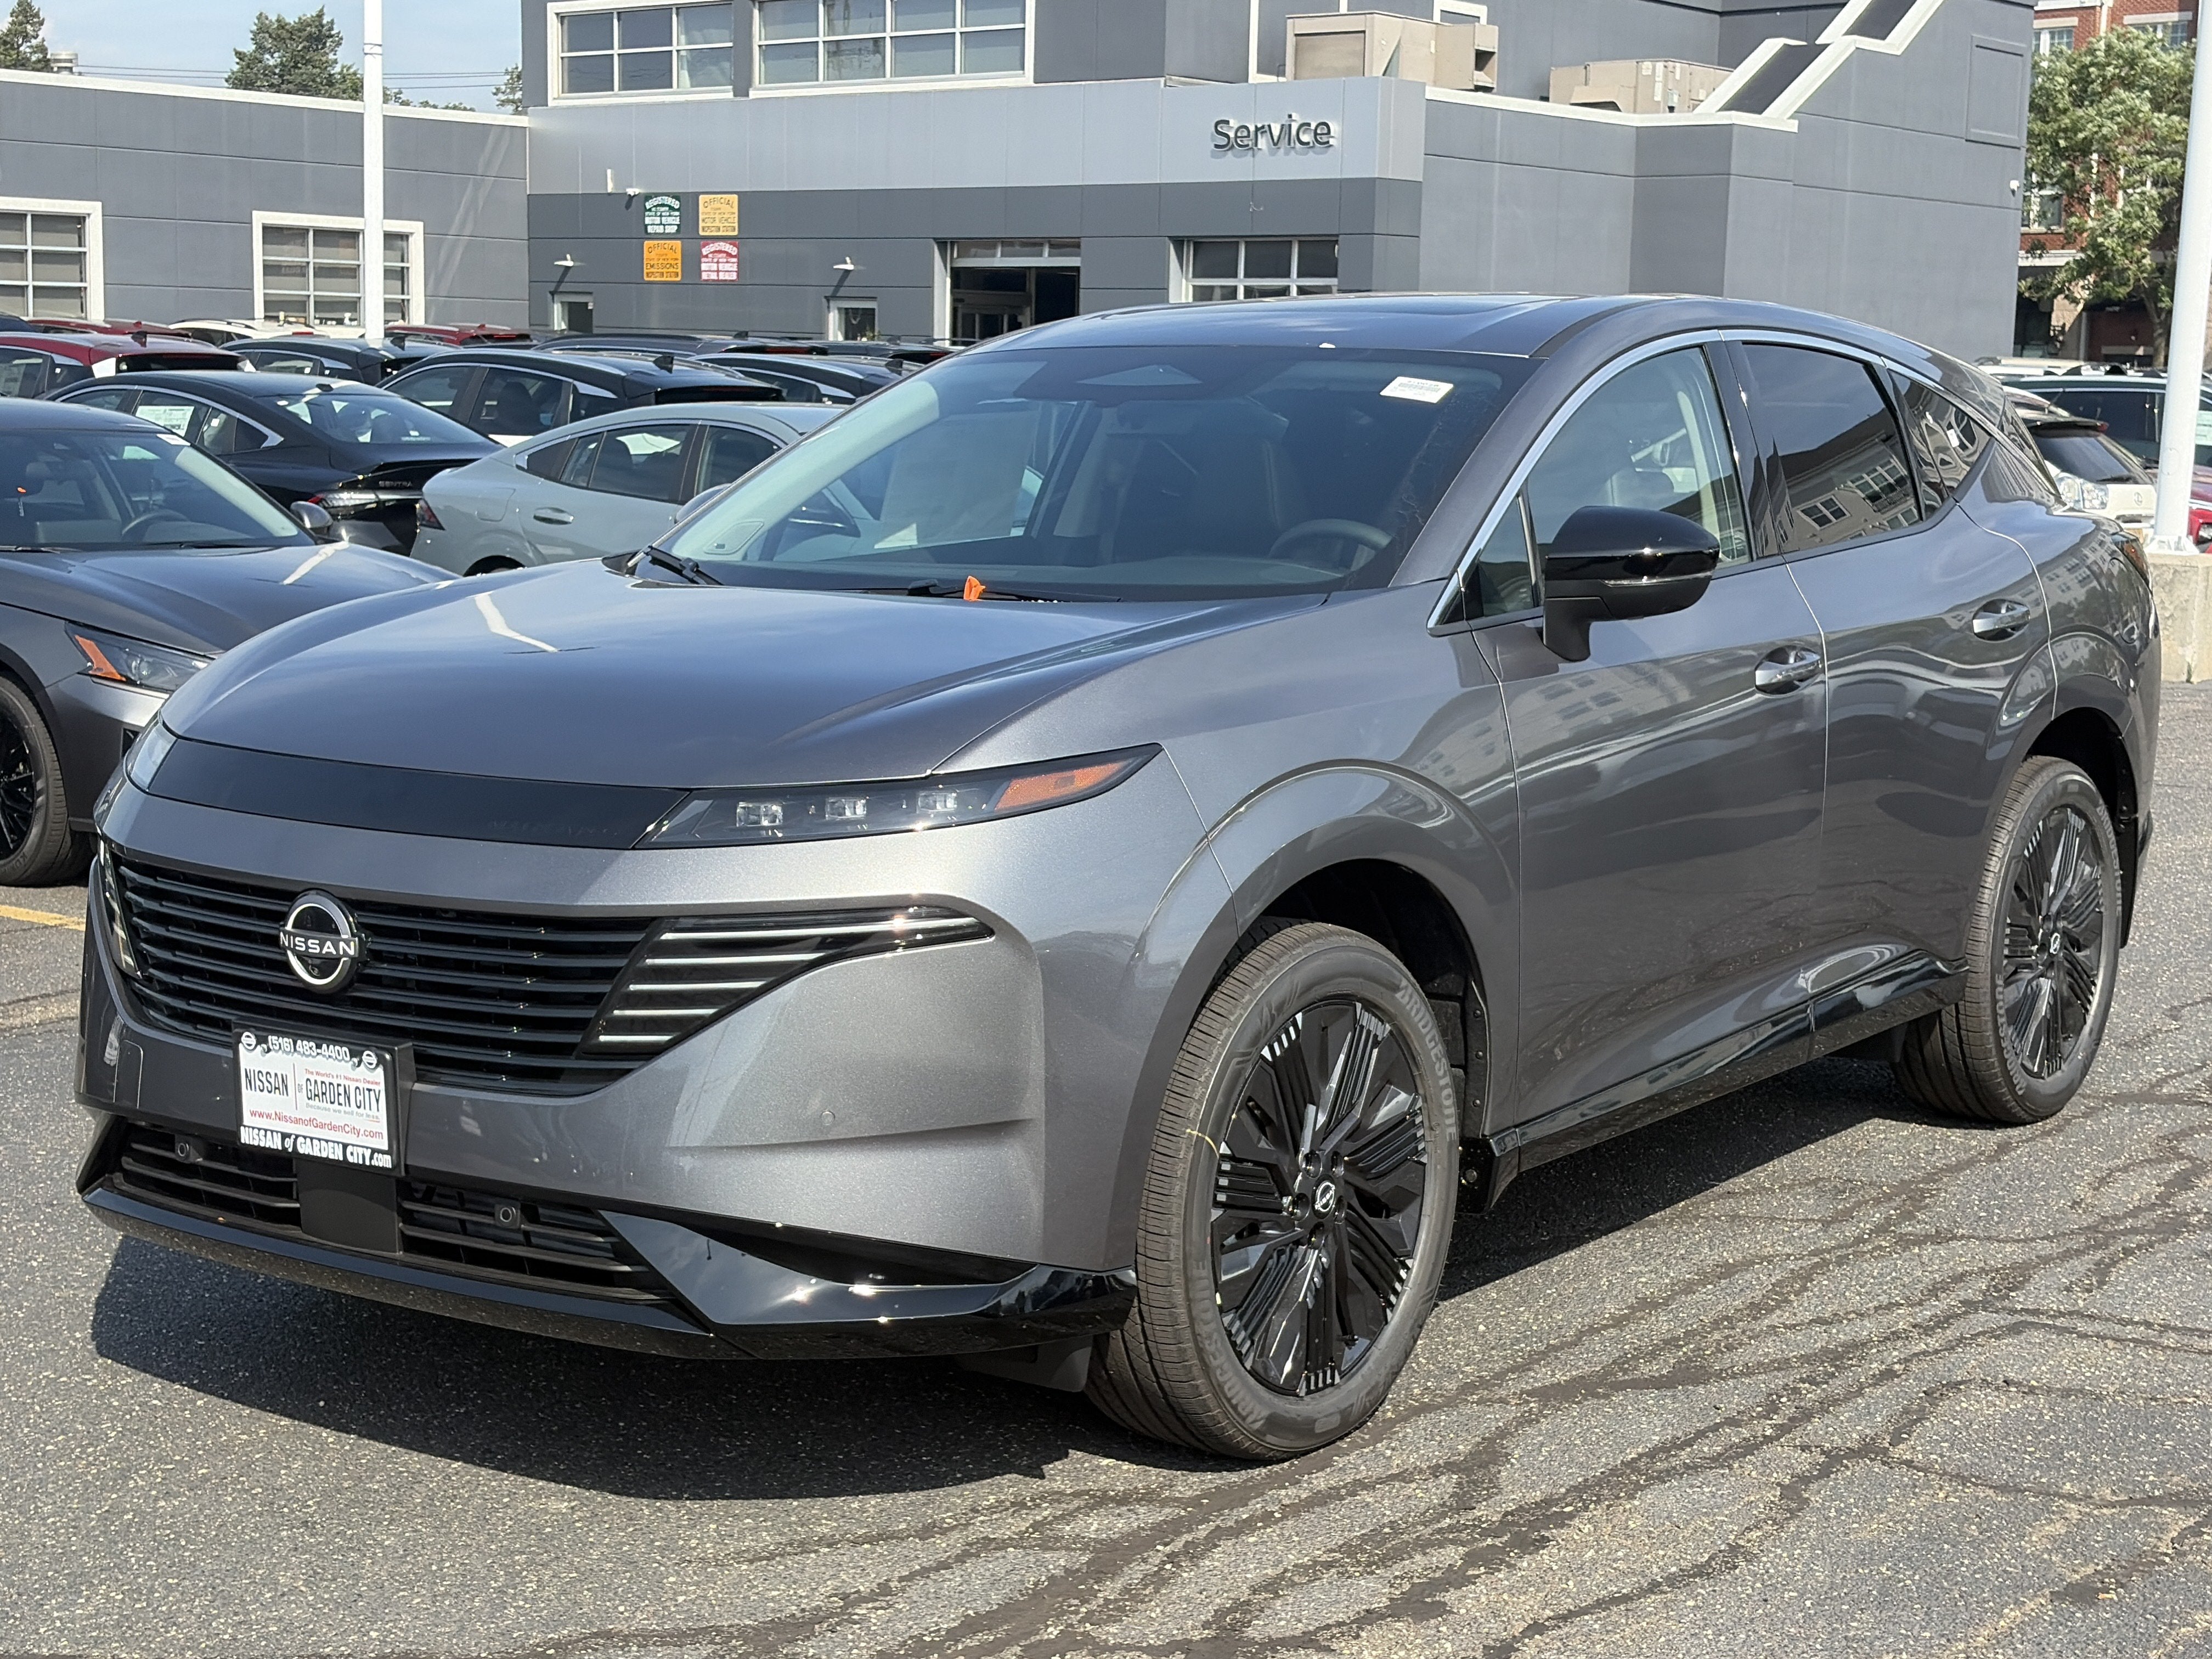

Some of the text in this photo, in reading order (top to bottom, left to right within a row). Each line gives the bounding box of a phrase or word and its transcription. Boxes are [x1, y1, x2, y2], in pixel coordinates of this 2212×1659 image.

[1213, 114, 1332, 150] Service
[703, 197, 734, 208] OFFICIAL
[647, 242, 677, 253] OFFICIAL
[280, 931, 354, 956] NISSAN
[268, 1035, 350, 1061] (516) 483-4400
[1396, 979, 1457, 1142] BRIDGESTONE
[245, 1068, 381, 1112] NISSAN OF GARDEN CITY
[343, 1075, 362, 1083] Nissan
[306, 1103, 331, 1113] Because
[249, 1109, 383, 1140] www.NissanofGardenCity.com
[240, 1126, 392, 1169] NISSAN of GARDEN CITY.com
